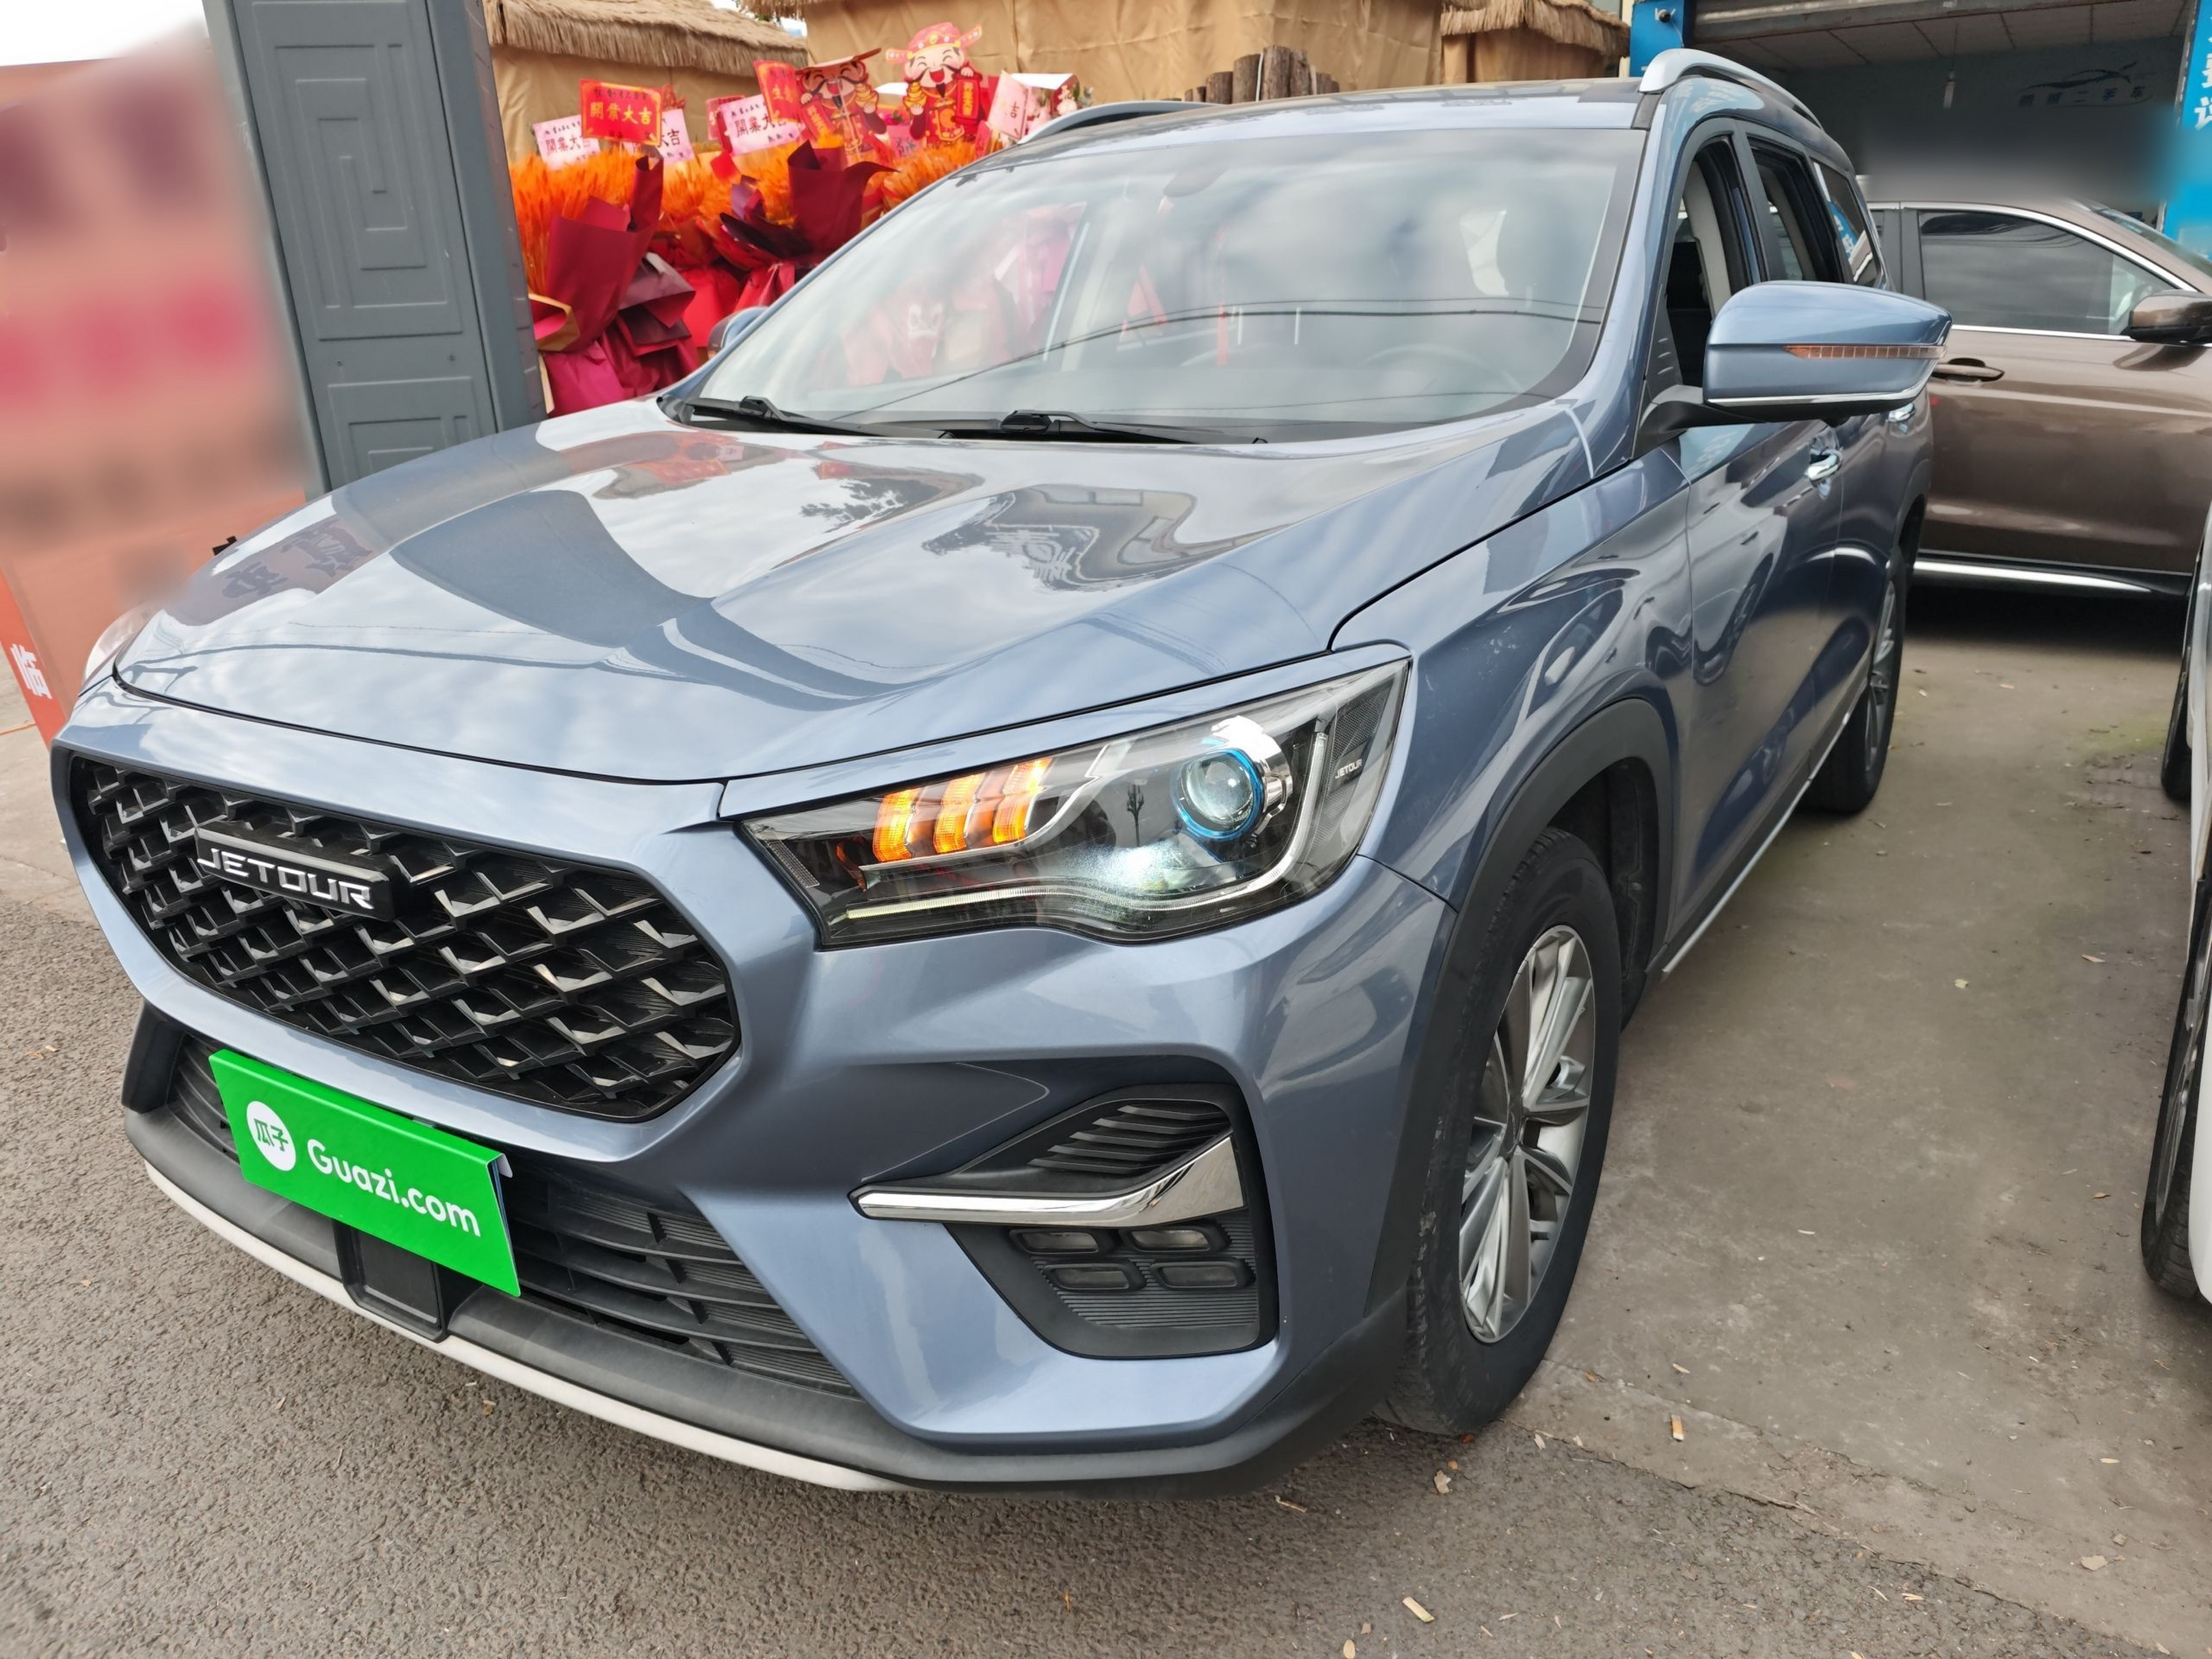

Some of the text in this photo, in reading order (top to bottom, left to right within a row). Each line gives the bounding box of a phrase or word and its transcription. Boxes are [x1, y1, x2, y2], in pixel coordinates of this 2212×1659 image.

[1335, 758, 1362, 779] JETOUR
[197, 848, 374, 910] JETOUR
[253, 1119, 289, 1152] 瓜子
[307, 1138, 481, 1237] Guazi.com
